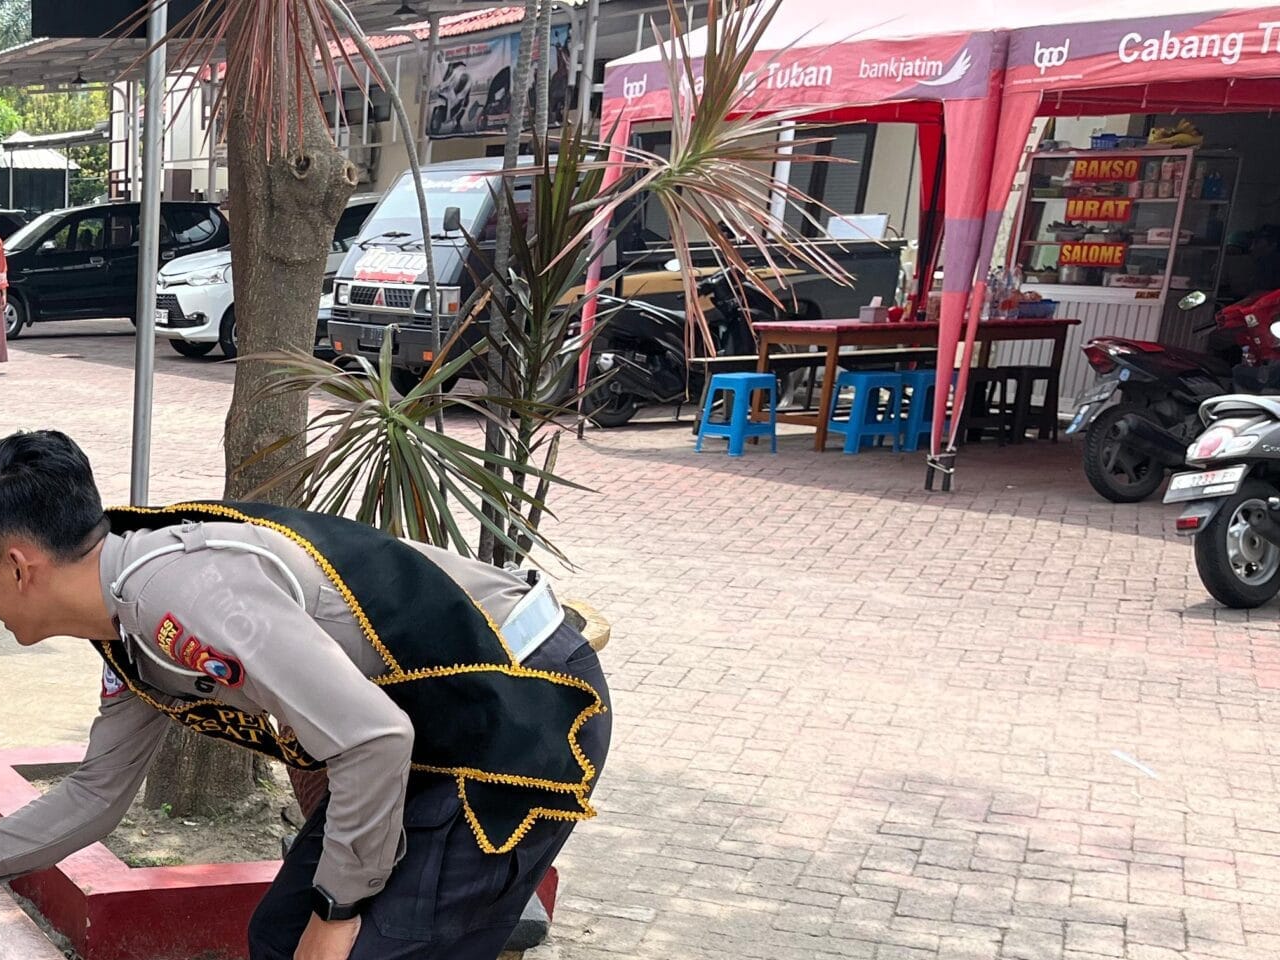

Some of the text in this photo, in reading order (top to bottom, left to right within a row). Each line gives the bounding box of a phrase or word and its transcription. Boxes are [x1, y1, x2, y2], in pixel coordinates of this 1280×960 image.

[1119, 21, 1280, 65] Cabang T
[767, 62, 833, 90] Tuban
[859, 57, 943, 83] bankjatim
[1074, 160, 1138, 178] BAKSO
[1067, 200, 1131, 218] URAT
[1061, 245, 1123, 264] SALOME
